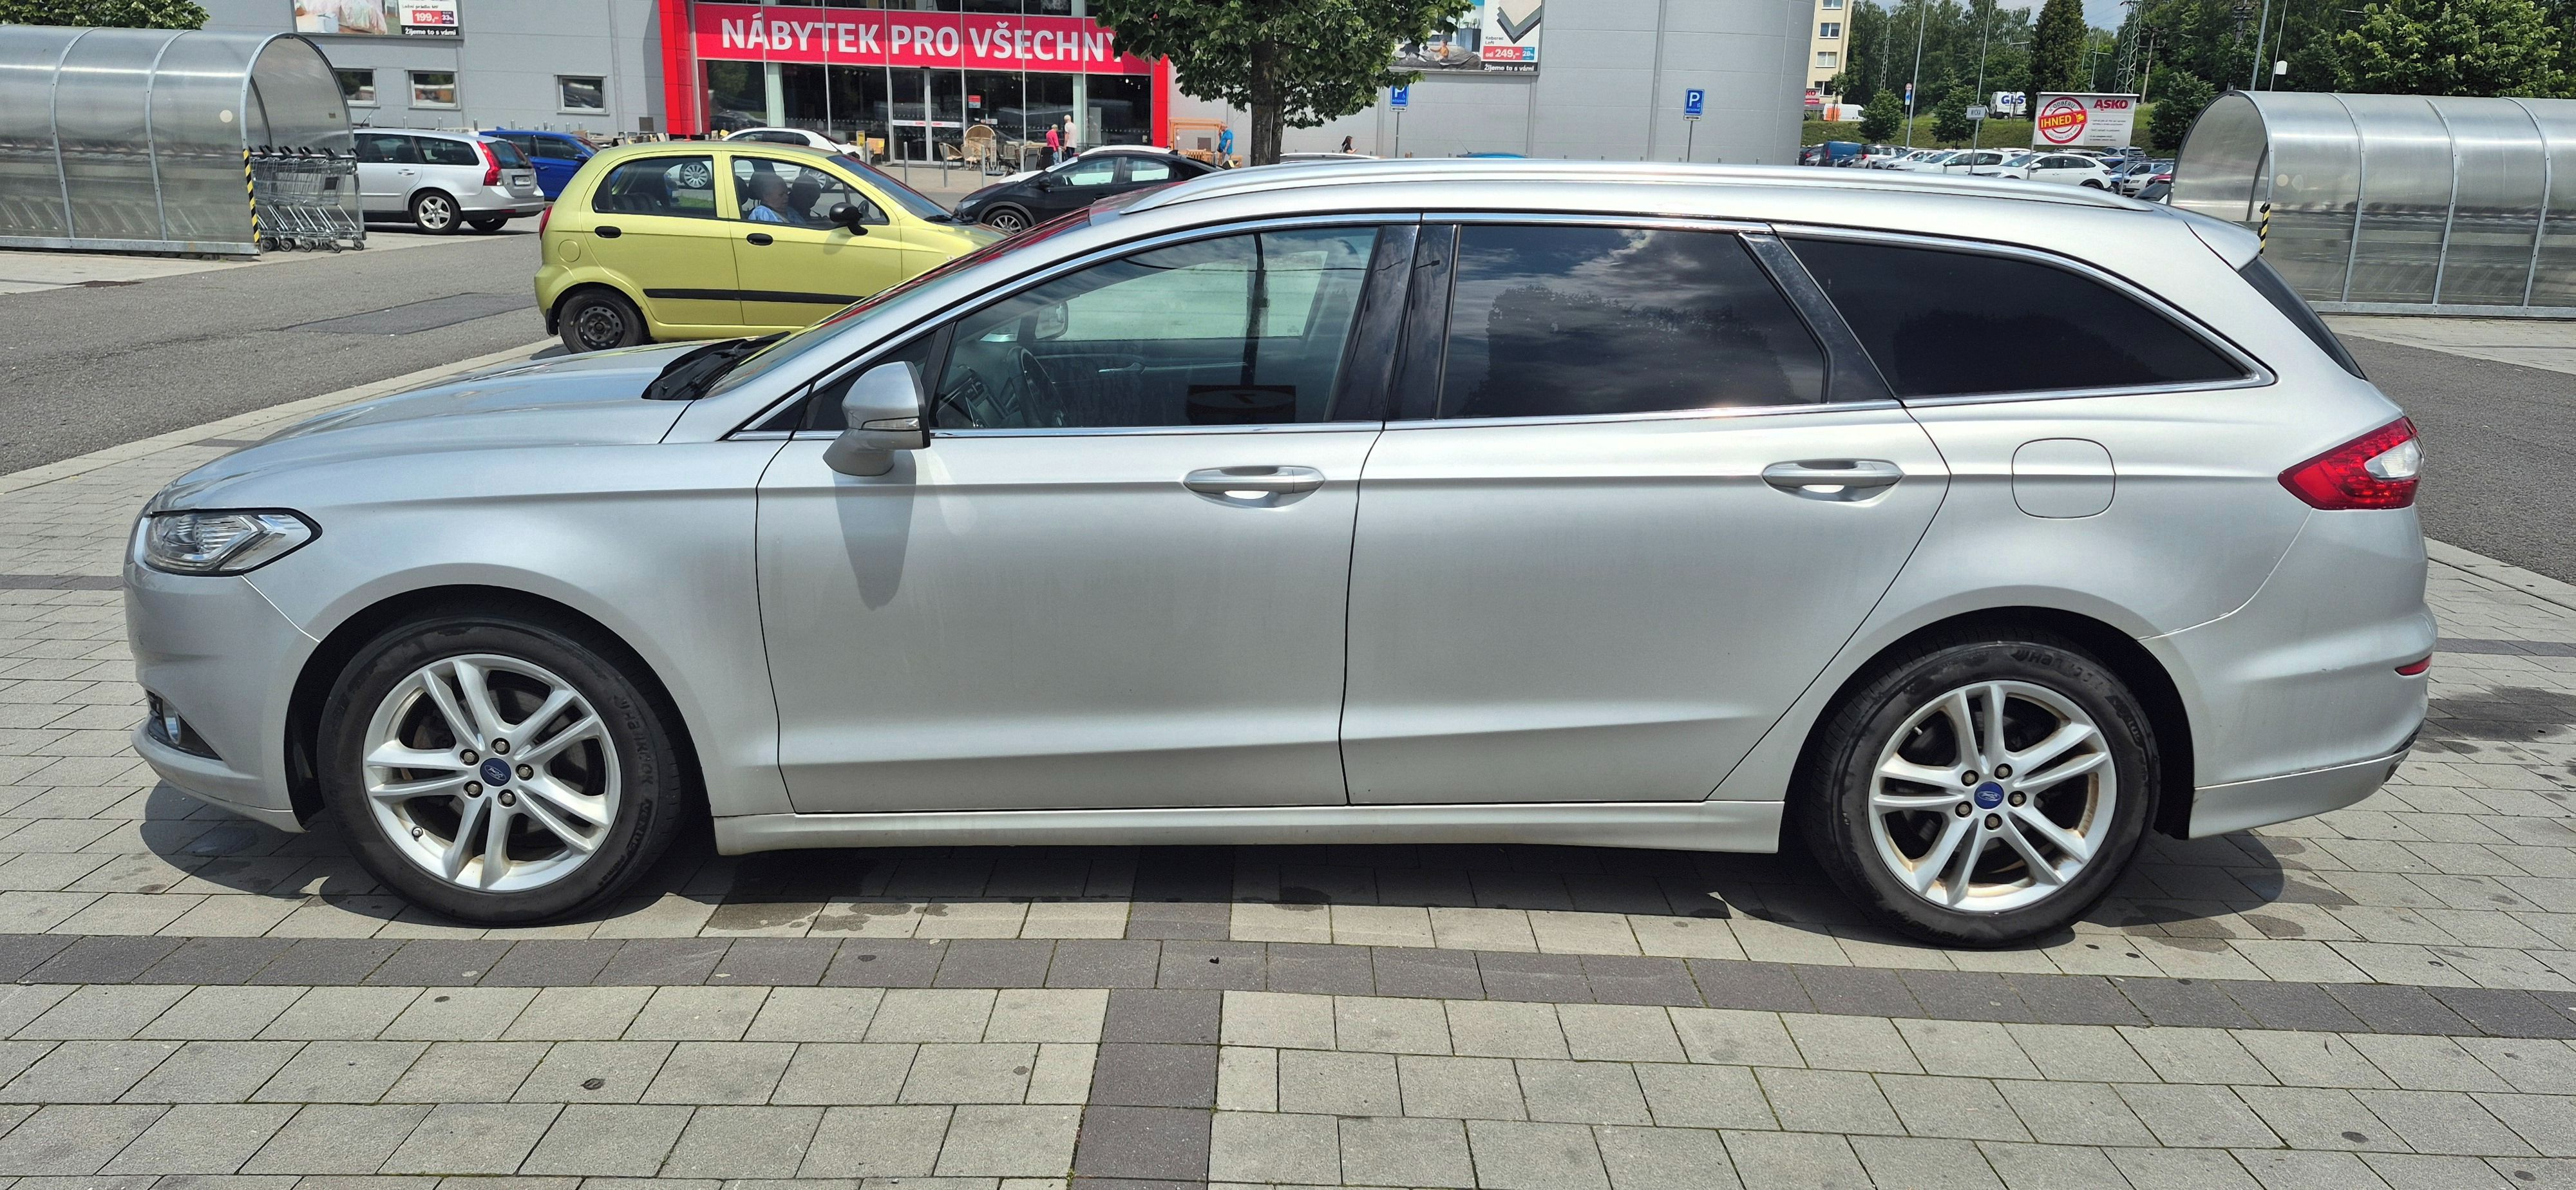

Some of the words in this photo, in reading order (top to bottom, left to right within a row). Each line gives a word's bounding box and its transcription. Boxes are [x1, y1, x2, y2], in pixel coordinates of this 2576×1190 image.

[721, 12, 881, 54] NÁBYTEK
[891, 24, 960, 57] PRO
[1689, 92, 1700, 107] P
[2001, 95, 2025, 104] GLS
[2094, 99, 2128, 111] ASKO
[2041, 115, 2072, 128] IHNED
